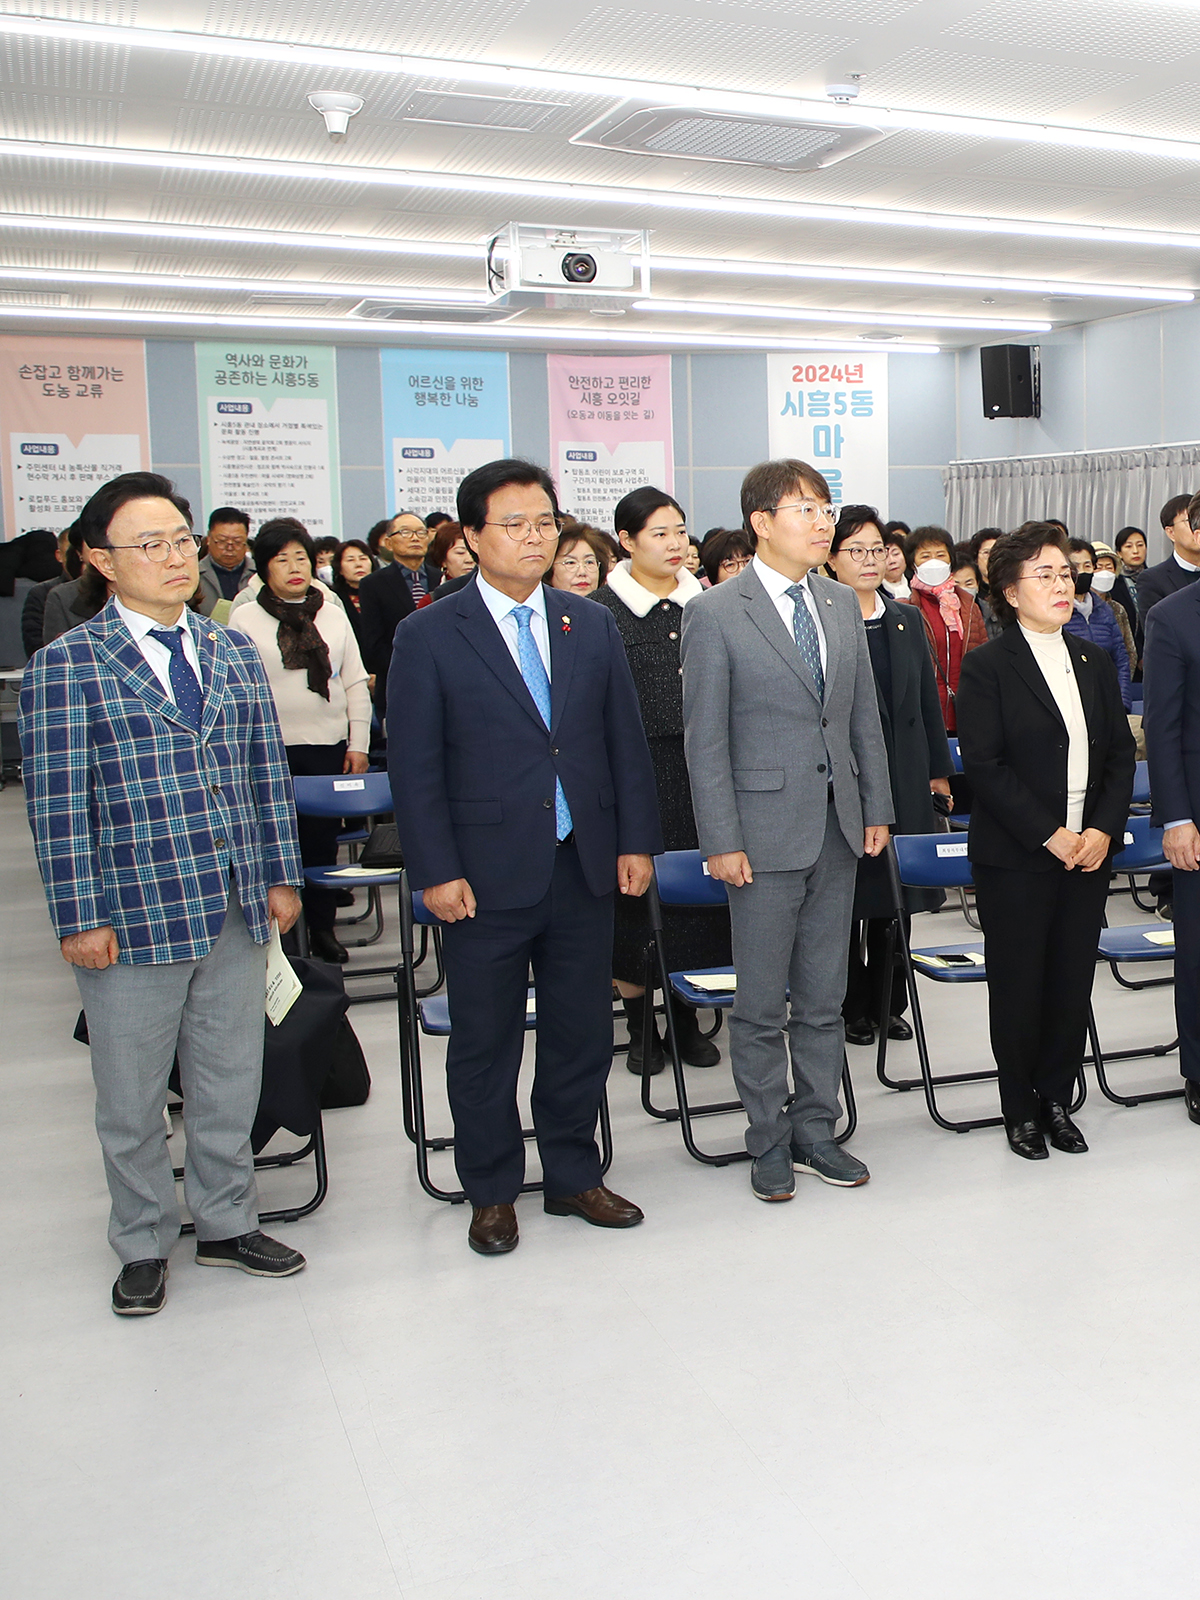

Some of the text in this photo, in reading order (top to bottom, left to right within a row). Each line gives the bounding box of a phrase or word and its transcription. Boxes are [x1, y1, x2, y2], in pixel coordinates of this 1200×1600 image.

[225, 353, 308, 369] 역사와 문화가
[19, 363, 124, 382] 손잡고 함께가는
[792, 363, 864, 384] 2024년
[215, 370, 320, 388] 공존하는 시흥5동
[408, 375, 485, 392] 어르신을 위한
[568, 375, 652, 391] 안전하고 편리한
[42, 383, 104, 398] 도농 교류
[414, 392, 480, 408] 행복한 나눔
[580, 392, 641, 406] 시흥 오잇길
[780, 389, 874, 418] 시흥5동
[219, 404, 249, 413] 사업내용
[567, 409, 655, 421] (오동과 이동을 잇는 길)
[23, 444, 56, 454] 사업내용
[403, 448, 432, 458] 사업내용
[567, 451, 594, 460] 사업내용
[26, 463, 56, 472] 주민센터
[58, 463, 66, 472] 내
[406, 467, 439, 475] 사각지대의
[440, 467, 466, 475] 어르신을
[592, 468, 611, 476] 어린이
[612, 468, 638, 477] 보호구역
[26, 473, 49, 481] 현수막
[51, 473, 67, 481] 게시
[79, 473, 94, 482] 판매
[406, 476, 426, 484] 마을이
[572, 477, 650, 485] 구간까지 확장하여 사업추진
[28, 495, 58, 503] 로컬푸드
